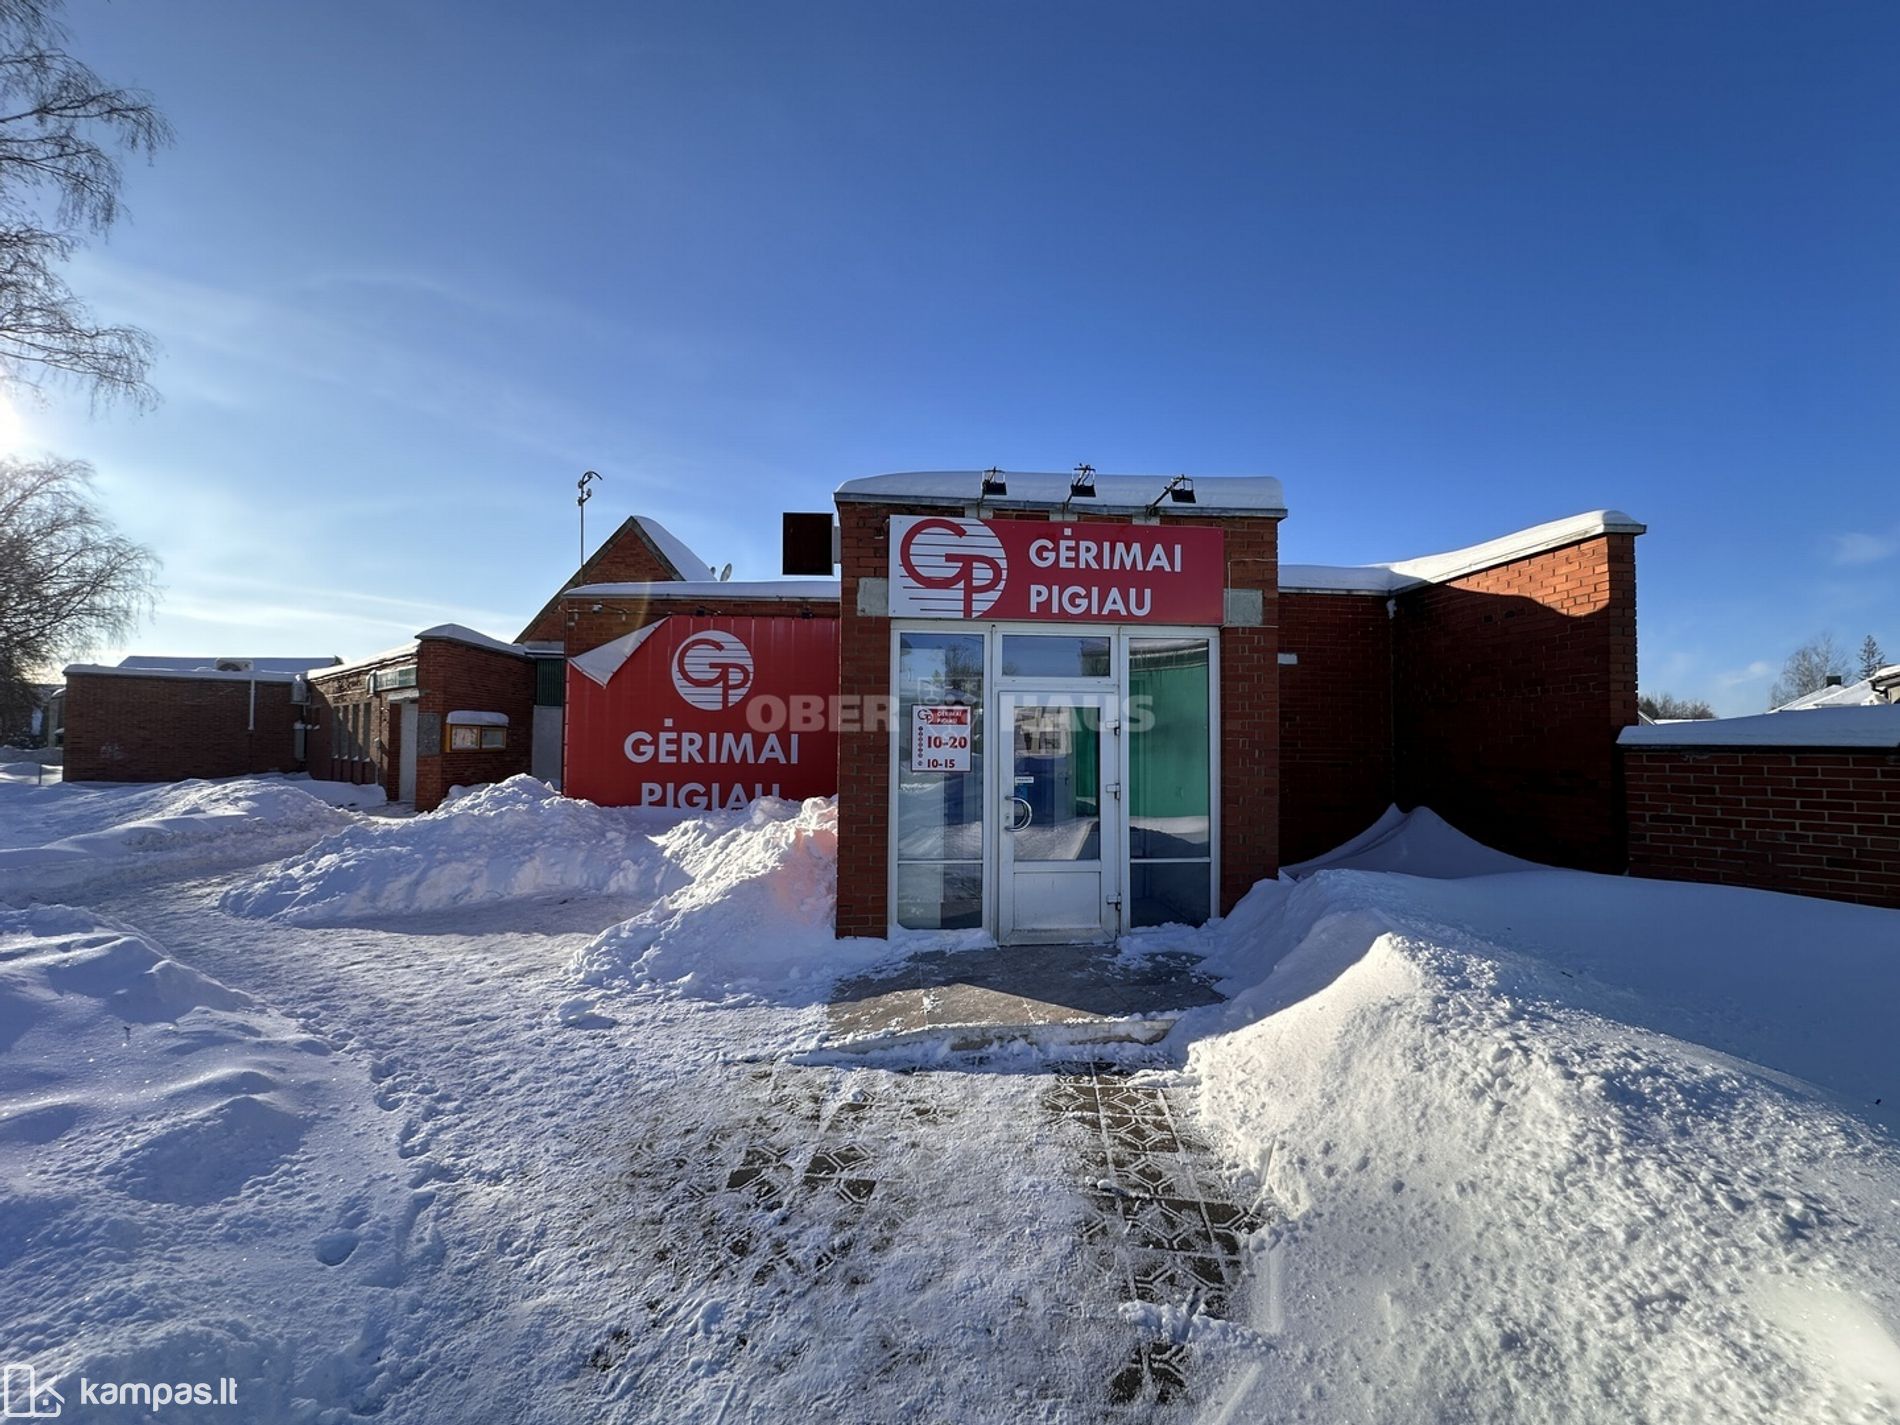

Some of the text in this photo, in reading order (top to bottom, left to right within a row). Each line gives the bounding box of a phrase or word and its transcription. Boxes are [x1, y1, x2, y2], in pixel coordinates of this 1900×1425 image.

[1029, 528, 1182, 572] GĖRIMAI
[1029, 585, 1152, 617] PIGIAU
[623, 718, 799, 765] GĖRIMAI
[927, 736, 967, 749] 10-20
[927, 759, 956, 768] 10-15
